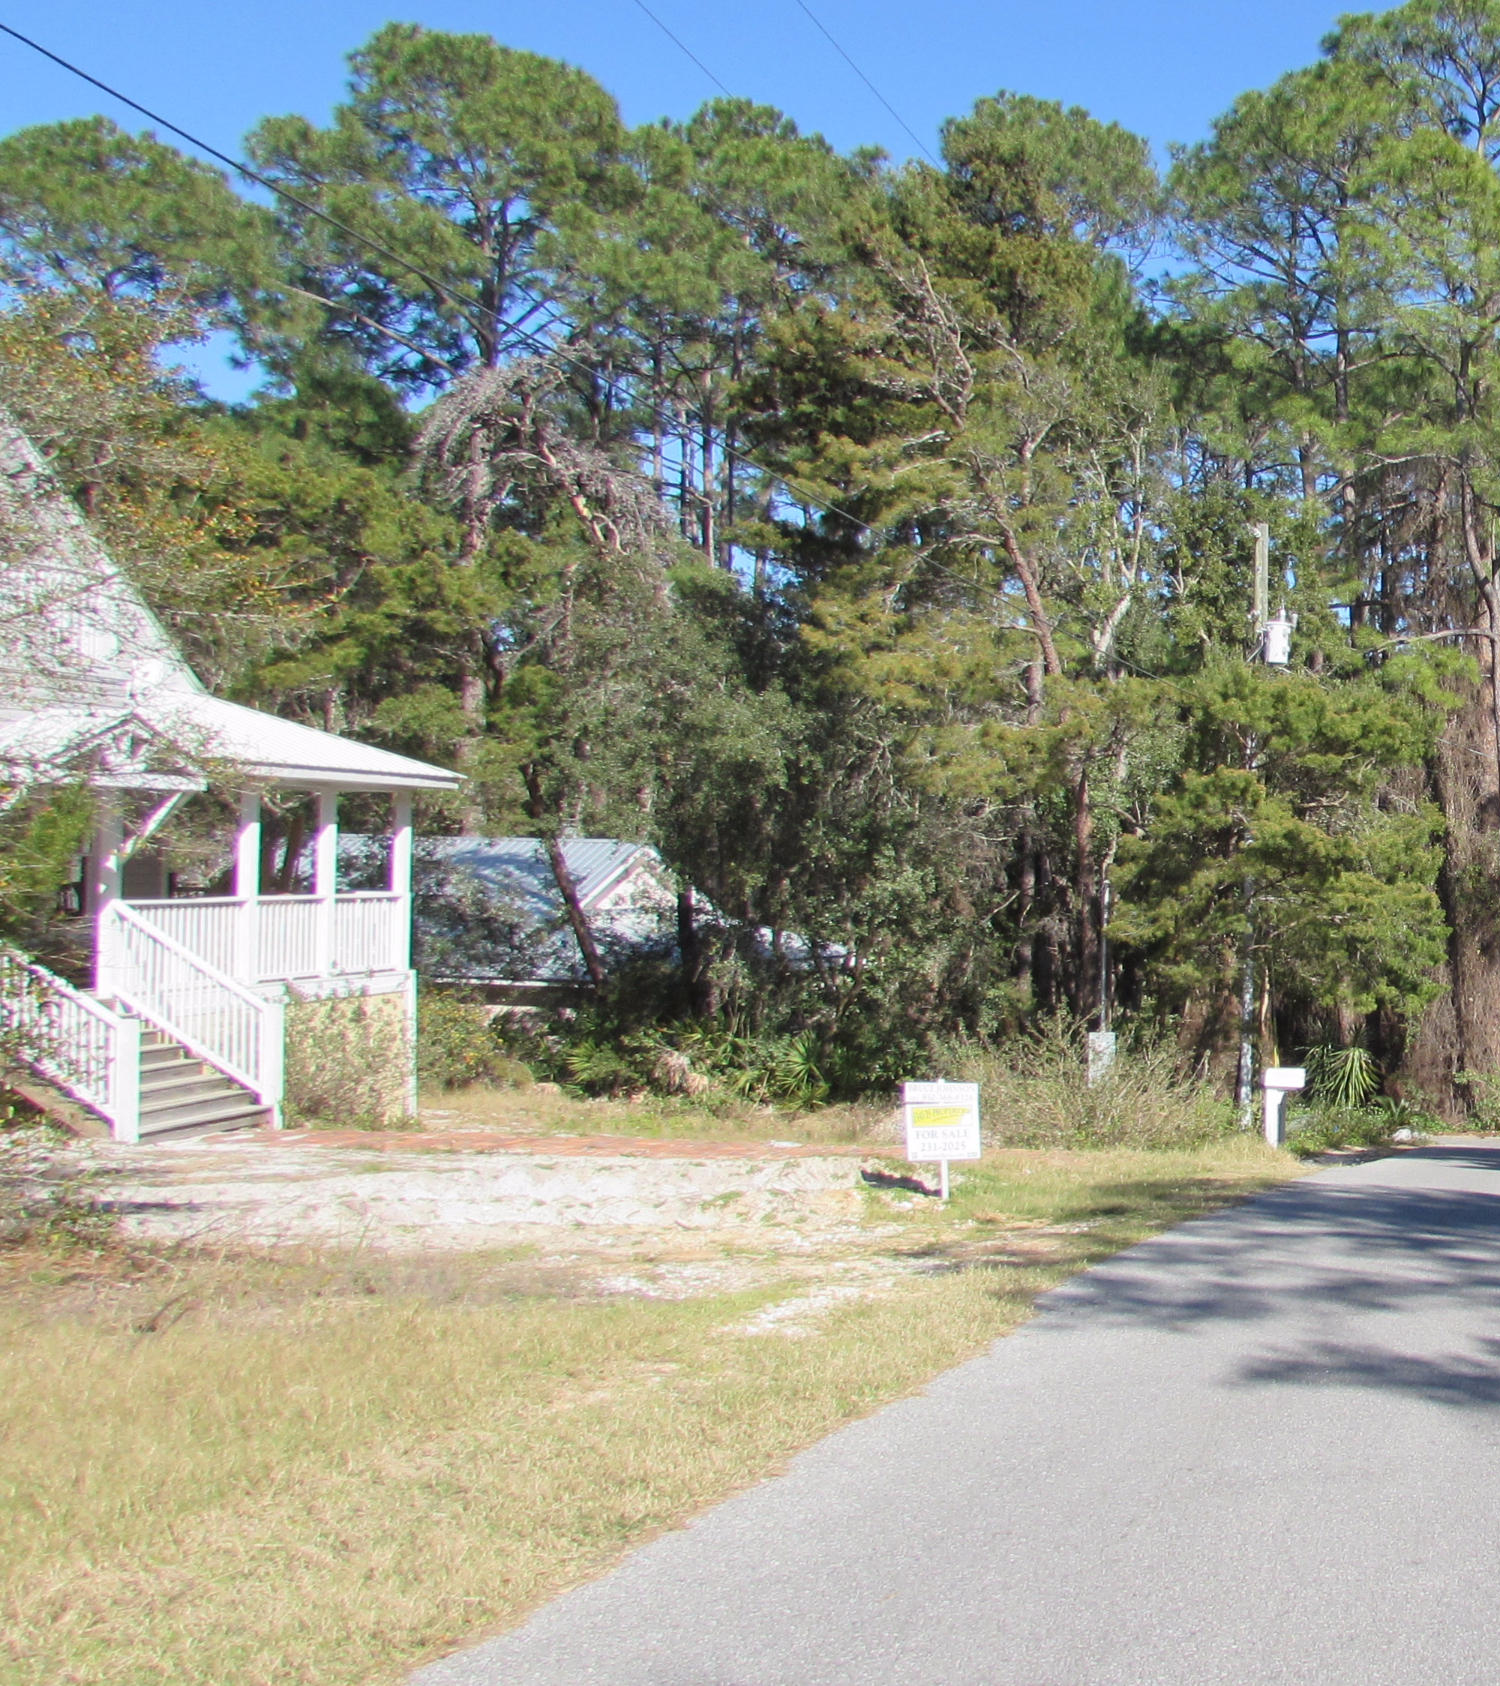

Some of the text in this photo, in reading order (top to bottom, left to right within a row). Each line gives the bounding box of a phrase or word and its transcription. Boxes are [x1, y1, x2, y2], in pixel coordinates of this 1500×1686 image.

[915, 1128, 968, 1140] FOR SALE
[920, 1141, 967, 1152] 231-2025
